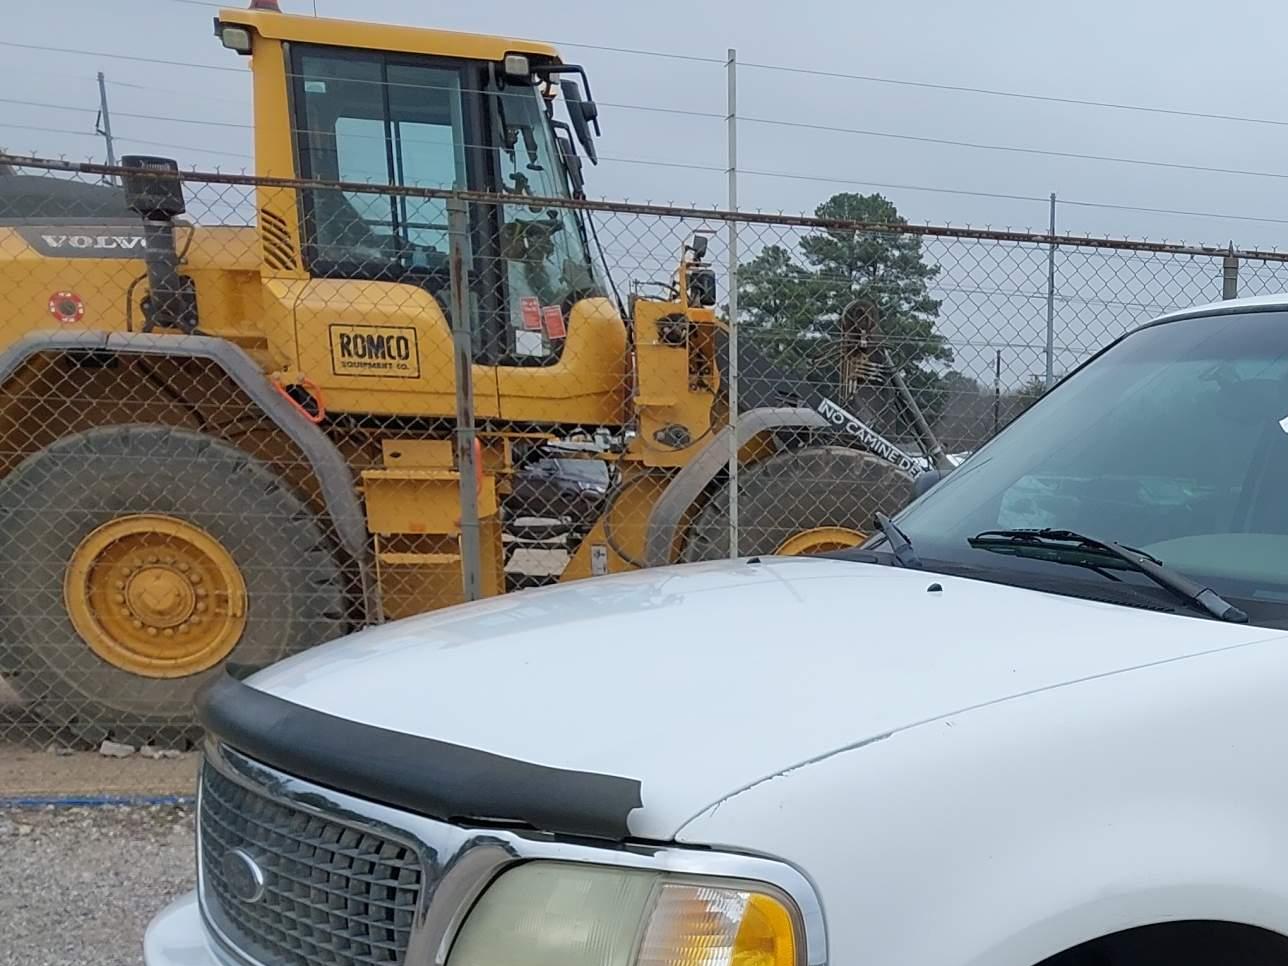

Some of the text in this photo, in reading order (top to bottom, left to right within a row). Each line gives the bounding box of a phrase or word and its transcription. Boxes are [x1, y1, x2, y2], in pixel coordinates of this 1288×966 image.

[339, 332, 410, 361] ROMCO
[341, 360, 393, 370] EQUIPMENT
[820, 402, 844, 425] NO
[845, 422, 900, 462] CAMINE
